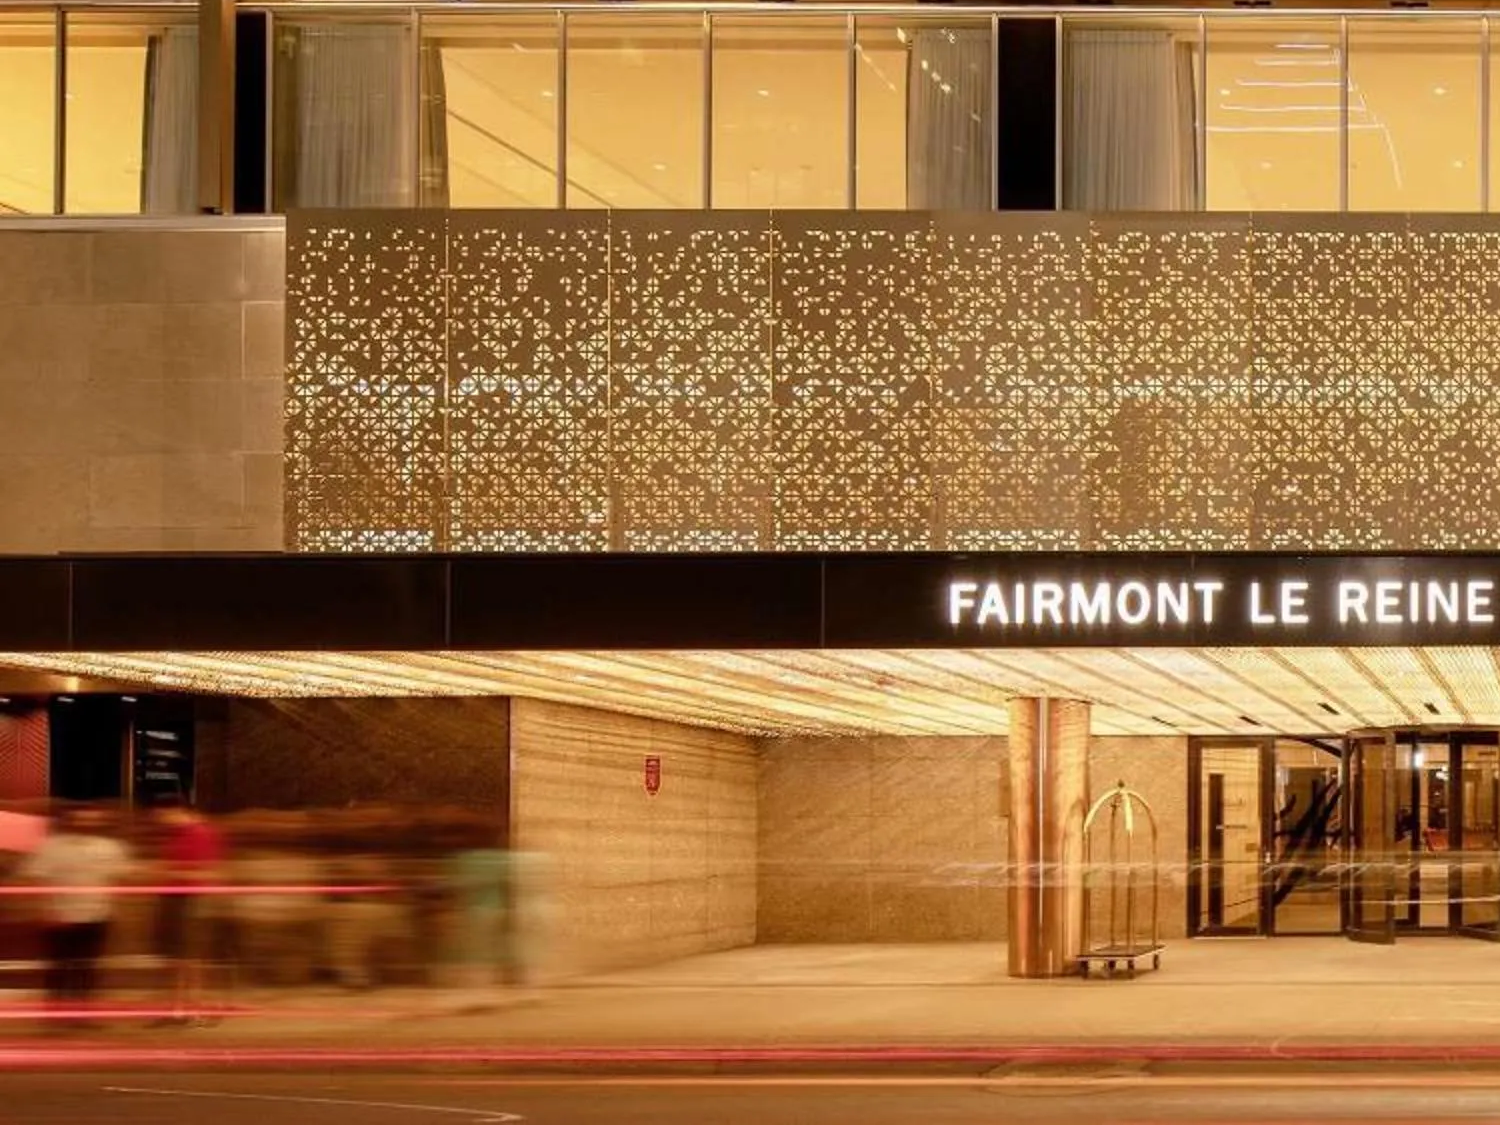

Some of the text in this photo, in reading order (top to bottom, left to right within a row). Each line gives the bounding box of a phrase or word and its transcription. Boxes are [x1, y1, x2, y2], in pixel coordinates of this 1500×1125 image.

[949, 581, 1223, 624] FAIRMONT
[1250, 581, 1309, 624] LE
[1338, 580, 1494, 623] REINE
